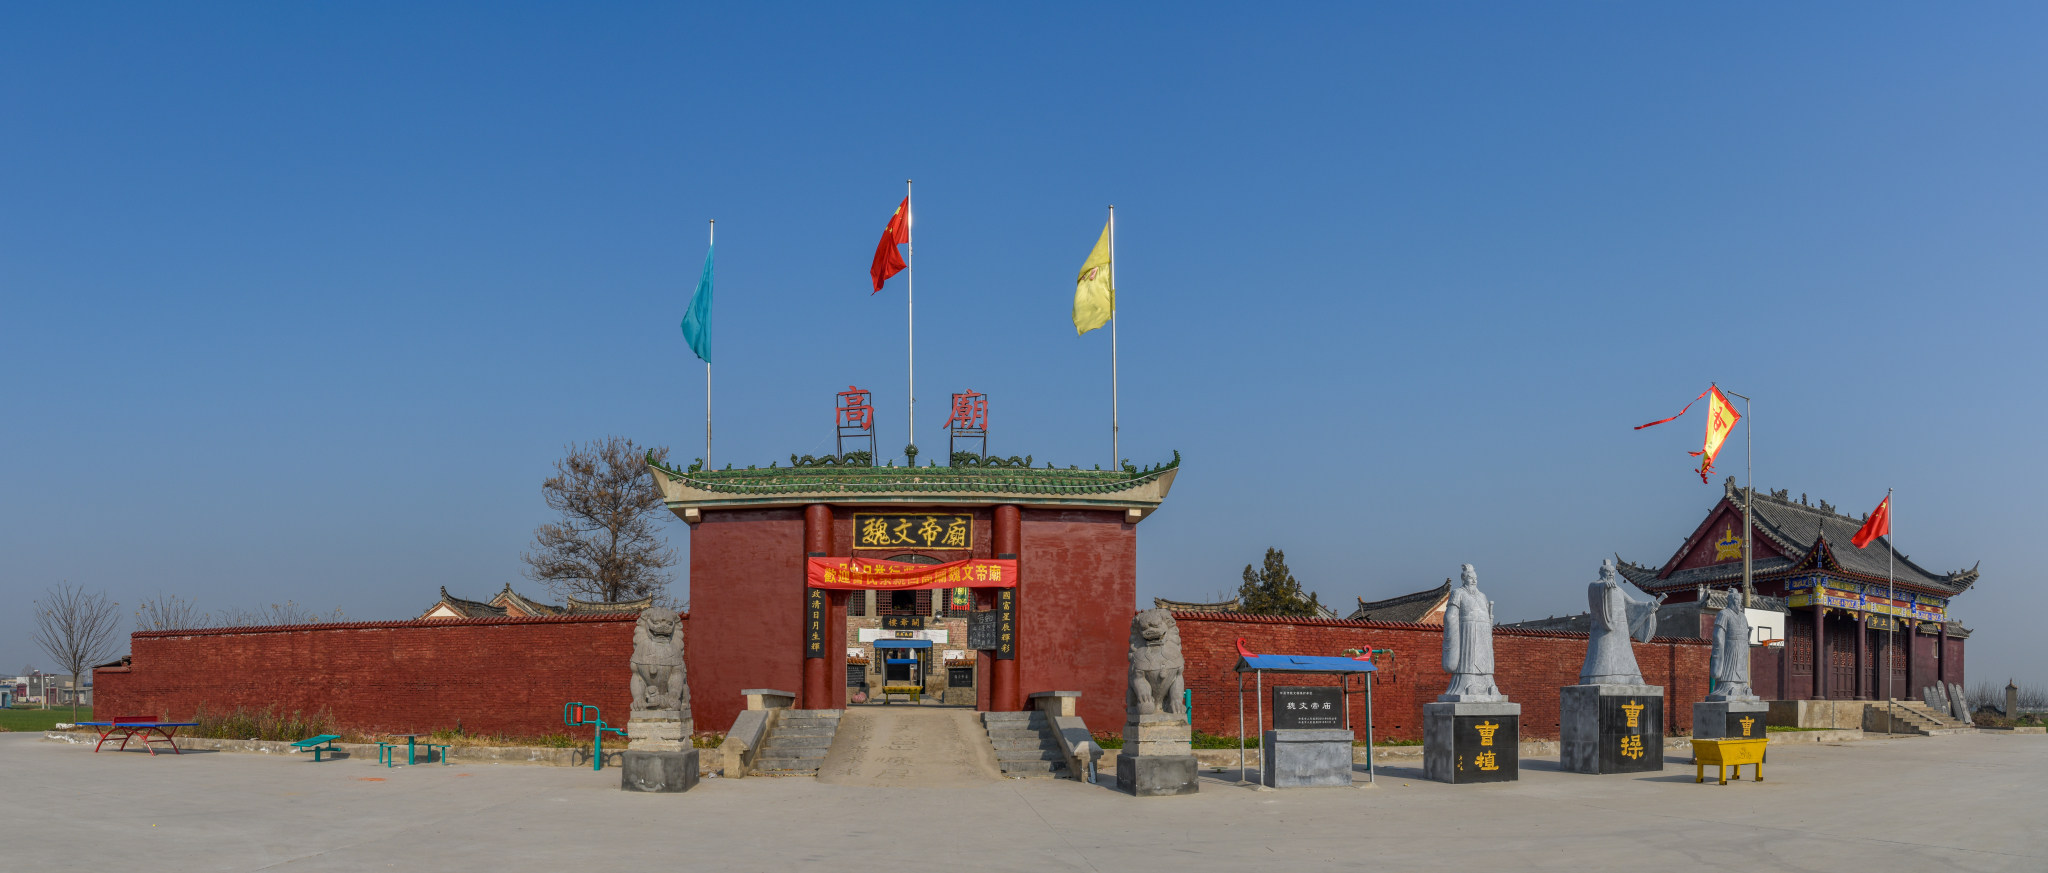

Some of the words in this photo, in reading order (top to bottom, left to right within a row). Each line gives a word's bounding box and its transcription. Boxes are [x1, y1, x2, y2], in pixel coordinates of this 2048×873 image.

[835, 385, 875, 431] 高
[943, 388, 988, 431] 廟
[862, 516, 966, 547] 魏文帝廟
[1286, 701, 1332, 710] 魏文帝庙
[1620, 699, 1645, 760] 曹操
[1739, 715, 1755, 736] 曹
[1474, 720, 1500, 771] 曹植
